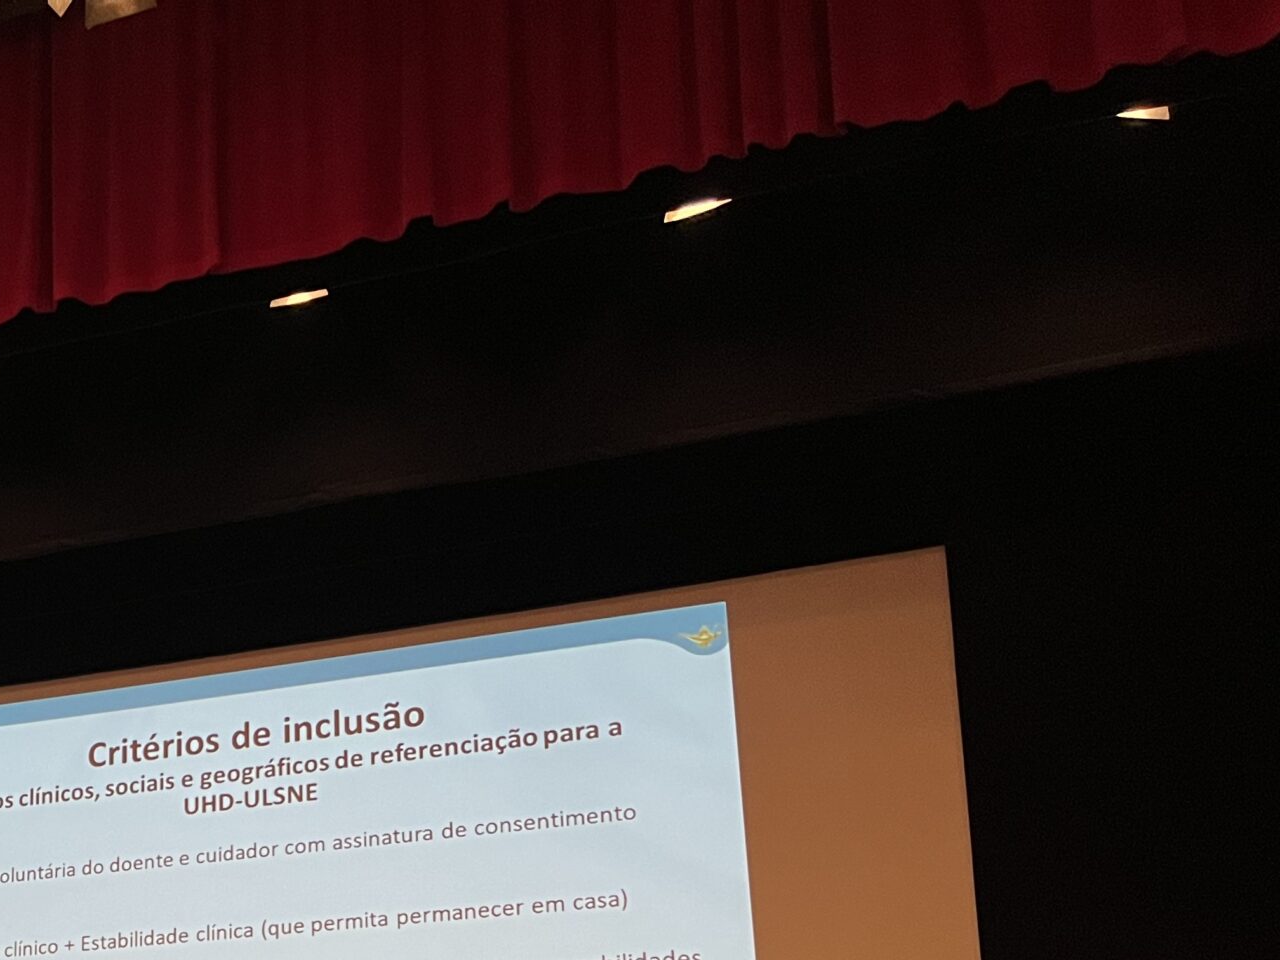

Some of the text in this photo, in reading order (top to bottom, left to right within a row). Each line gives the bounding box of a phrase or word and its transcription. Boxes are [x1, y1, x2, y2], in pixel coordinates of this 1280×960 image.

[18, 784, 101, 807] clínicos,
[104, 771, 175, 798] sociais
[180, 773, 194, 788] e
[199, 756, 330, 791] geográficos
[334, 748, 364, 770] de
[370, 727, 539, 766] referenciação
[543, 724, 600, 750] para
[608, 721, 622, 737] a
[88, 701, 425, 768] Critérios de inclusão
[183, 782, 319, 816] UHD-ULSNE
[81, 859, 105, 876] do
[109, 854, 174, 873] doente
[178, 853, 190, 866] e
[195, 841, 280, 864] cuidador
[284, 839, 326, 856] com
[332, 828, 434, 851] assinatura
[441, 821, 468, 840] de
[474, 806, 637, 836] consentimento
[4, 940, 59, 958] clínico
[81, 927, 189, 952] Estabilidade
[195, 923, 254, 943] clínica
[261, 919, 305, 941] (que
[311, 911, 389, 937] permita
[396, 902, 525, 930] permanecer
[531, 899, 565, 914] em
[572, 888, 628, 912] casa)
